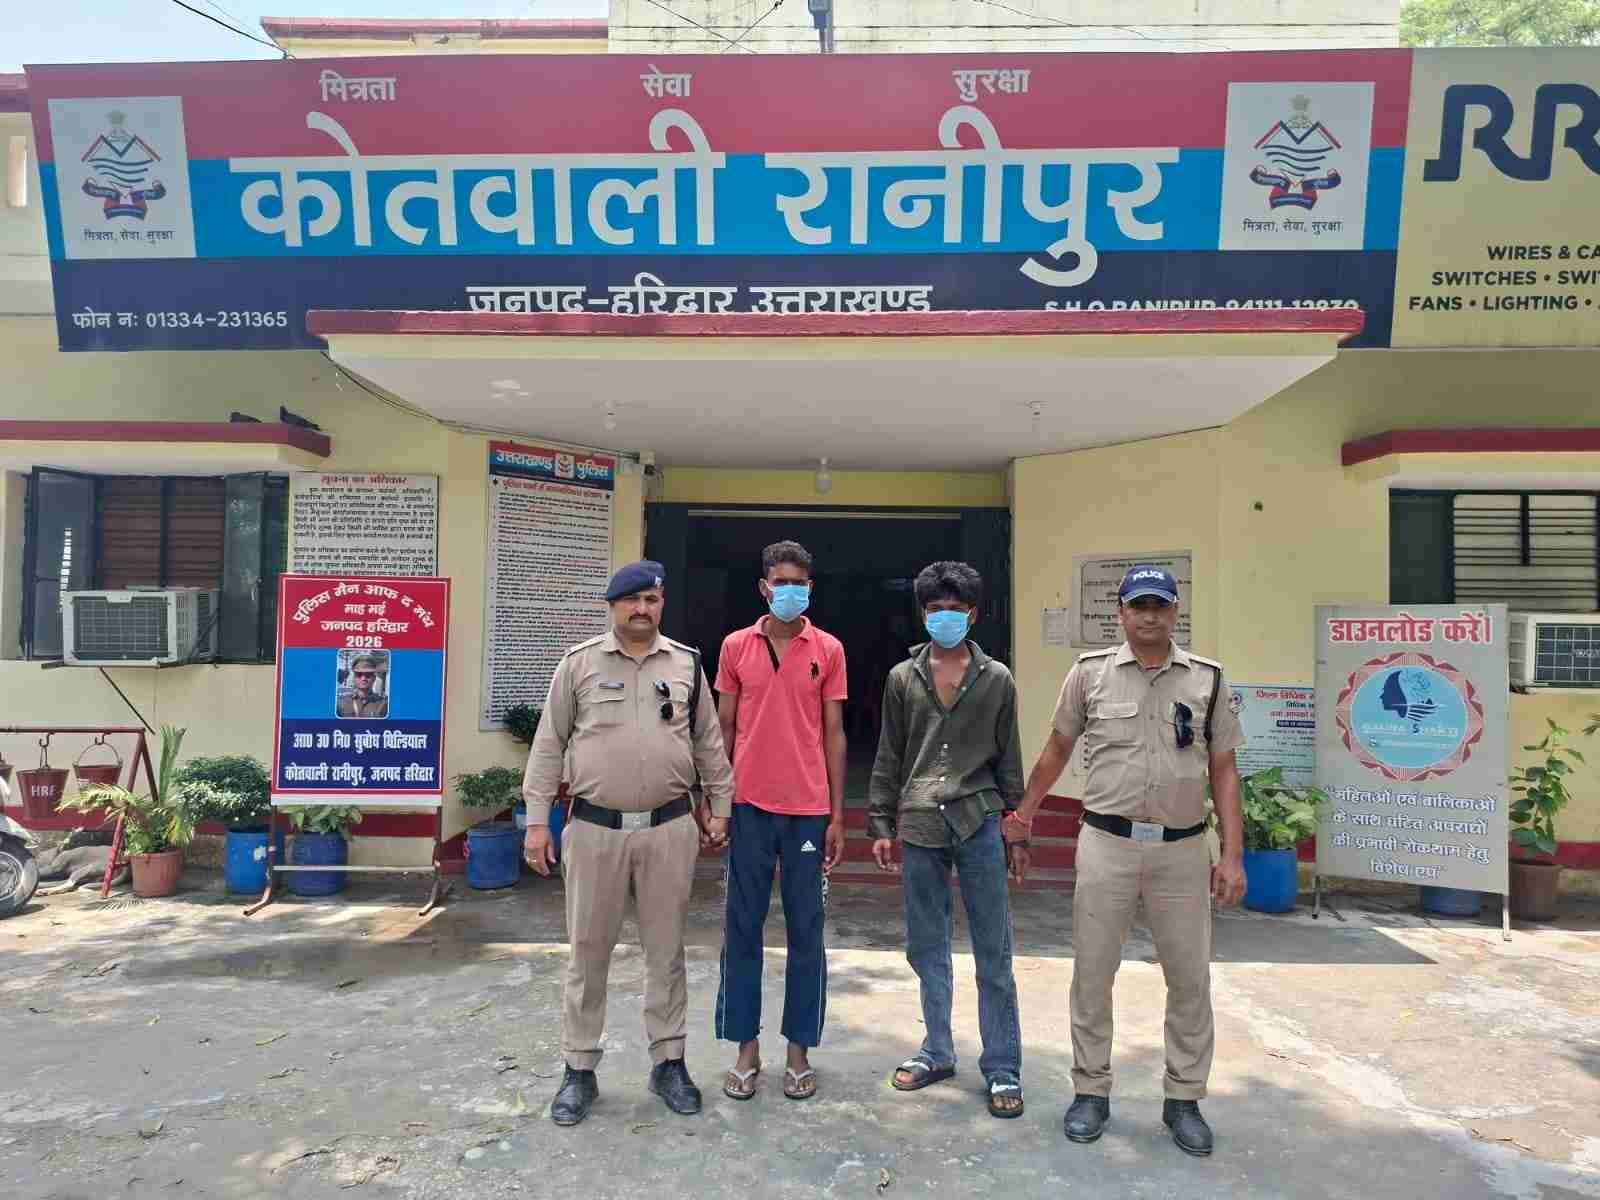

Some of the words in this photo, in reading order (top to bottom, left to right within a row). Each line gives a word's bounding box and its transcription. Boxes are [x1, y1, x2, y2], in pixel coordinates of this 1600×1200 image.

[318, 69, 397, 103] मित्रता
[640, 64, 692, 98] सेवा
[952, 68, 1031, 103] सुरक्षा
[228, 108, 726, 248] कोतवाली
[764, 105, 1180, 287] रानीपुर
[1487, 245, 1553, 261] WIRES
[1557, 246, 1571, 260] &
[1431, 270, 1537, 286] SWITCHES
[749, 284, 934, 313] उत्तराखण्ड
[1408, 296, 1463, 312] FANS
[1483, 295, 1578, 311] LIGHTING
[72, 307, 112, 330] फोन
[145, 310, 288, 329] 01334-231365
[1132, 569, 1166, 581] POLICE
[320, 619, 364, 632] जनपद
[366, 617, 410, 634] हरिद्वार
[1328, 612, 1435, 643] डाउनलोड
[345, 635, 384, 649] 2026
[284, 761, 329, 782] कोतवाली
[370, 765, 402, 782] जनपद
[403, 762, 435, 782] हरिद्वार
[1351, 812, 1383, 827] साथ
